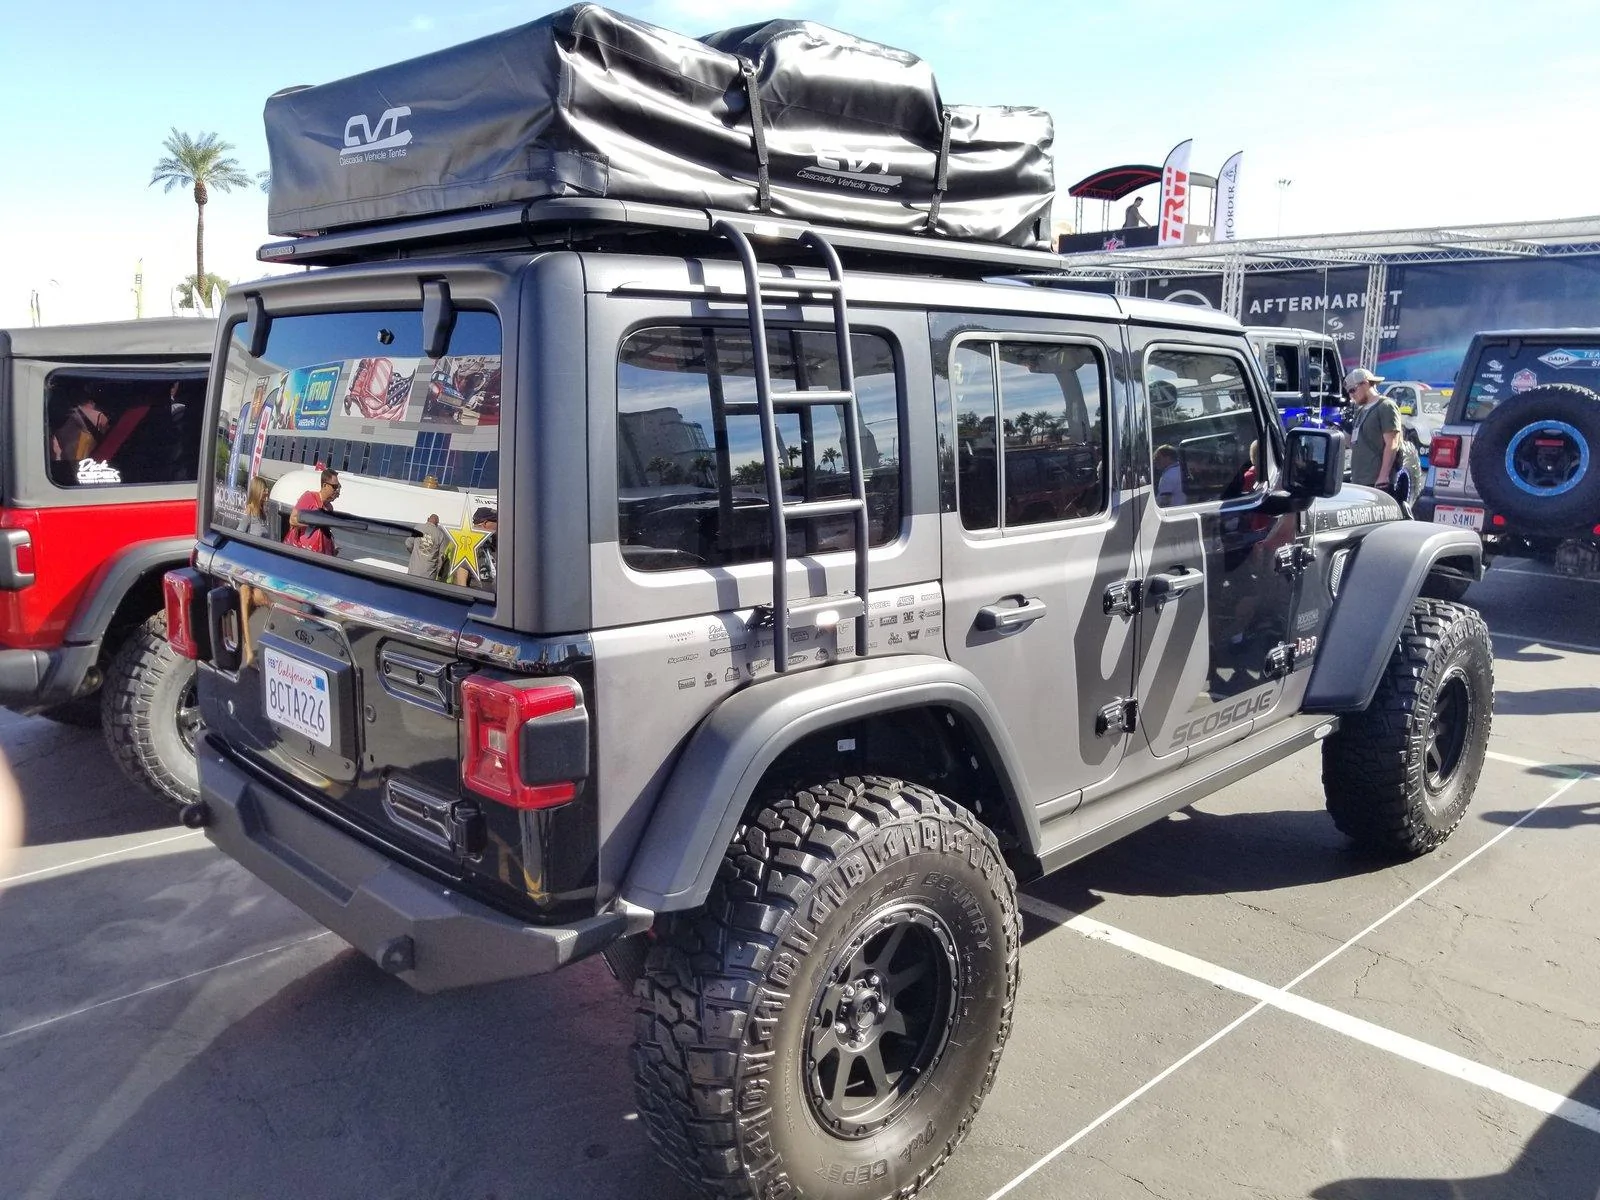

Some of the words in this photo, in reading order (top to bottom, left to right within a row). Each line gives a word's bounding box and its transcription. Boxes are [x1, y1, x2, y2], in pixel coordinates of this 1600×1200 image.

[344, 106, 411, 147] CVT
[340, 155, 363, 166] Cascadia
[364, 151, 387, 162] Vehicle
[388, 149, 407, 158] Tents
[797, 169, 836, 184] Cascadia
[838, 177, 866, 189] Vehicle
[868, 183, 890, 194] Tents
[1161, 166, 1187, 242] TRW
[1548, 355, 1569, 364] DANA
[77, 470, 121, 480] CEPEK
[79, 458, 109, 471] Dick
[1336, 507, 1372, 526] GEN-RIGHT
[1373, 506, 1384, 521] OFF
[1453, 512, 1475, 525] S4MU
[1294, 636, 1317, 657] Jeep
[277, 660, 316, 690] California
[269, 678, 325, 733] 8CTA226
[1169, 689, 1274, 749] SCOSCHE
[921, 871, 991, 951] COUNTRY
[815, 1158, 888, 1184] CEPEK
